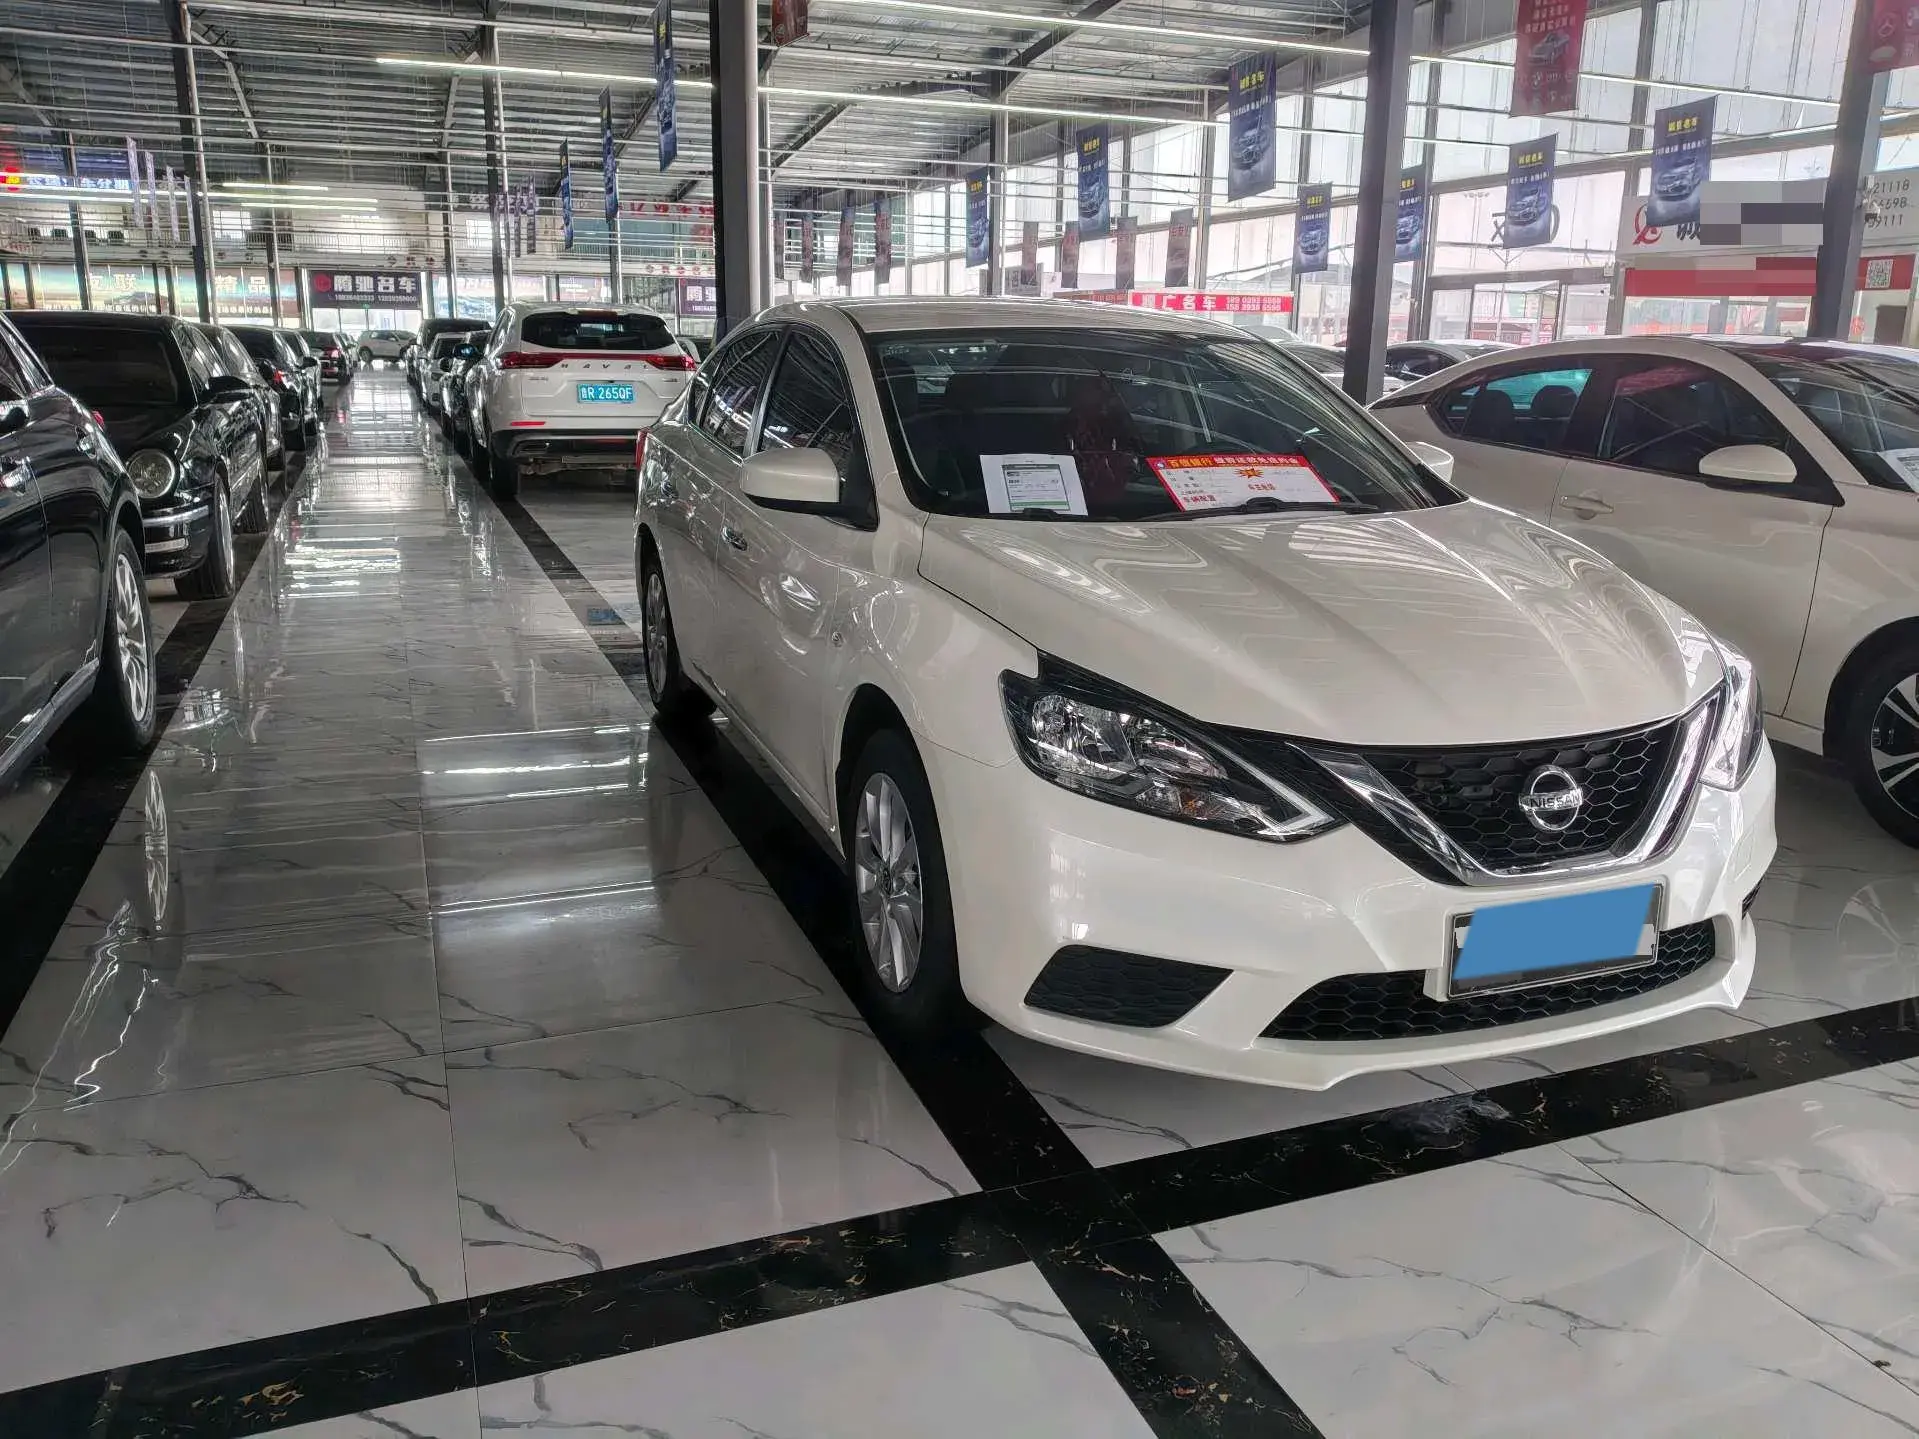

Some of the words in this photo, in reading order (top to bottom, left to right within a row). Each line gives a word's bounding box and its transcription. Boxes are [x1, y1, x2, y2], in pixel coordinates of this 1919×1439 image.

[333, 275, 416, 293] 腾驰名车
[1530, 791, 1581, 808] NISSAN
